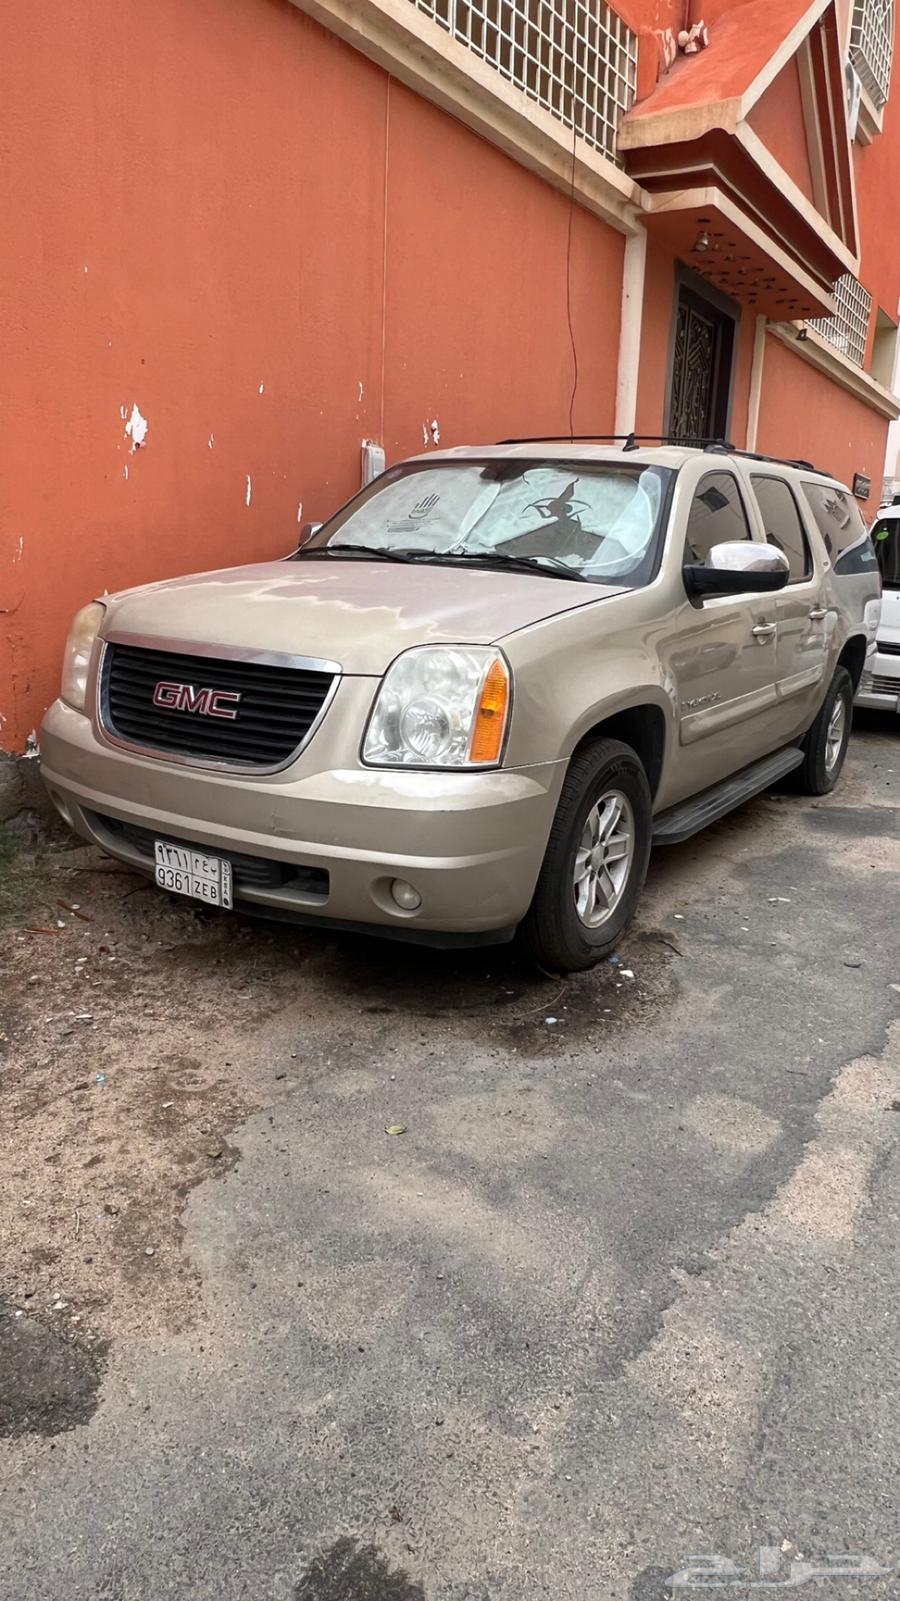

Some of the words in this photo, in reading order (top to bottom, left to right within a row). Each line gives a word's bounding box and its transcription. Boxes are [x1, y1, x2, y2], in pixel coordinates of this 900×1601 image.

[153, 681, 241, 719] GMC
[158, 868, 190, 893] 9361
[194, 880, 217, 899] ZEB
